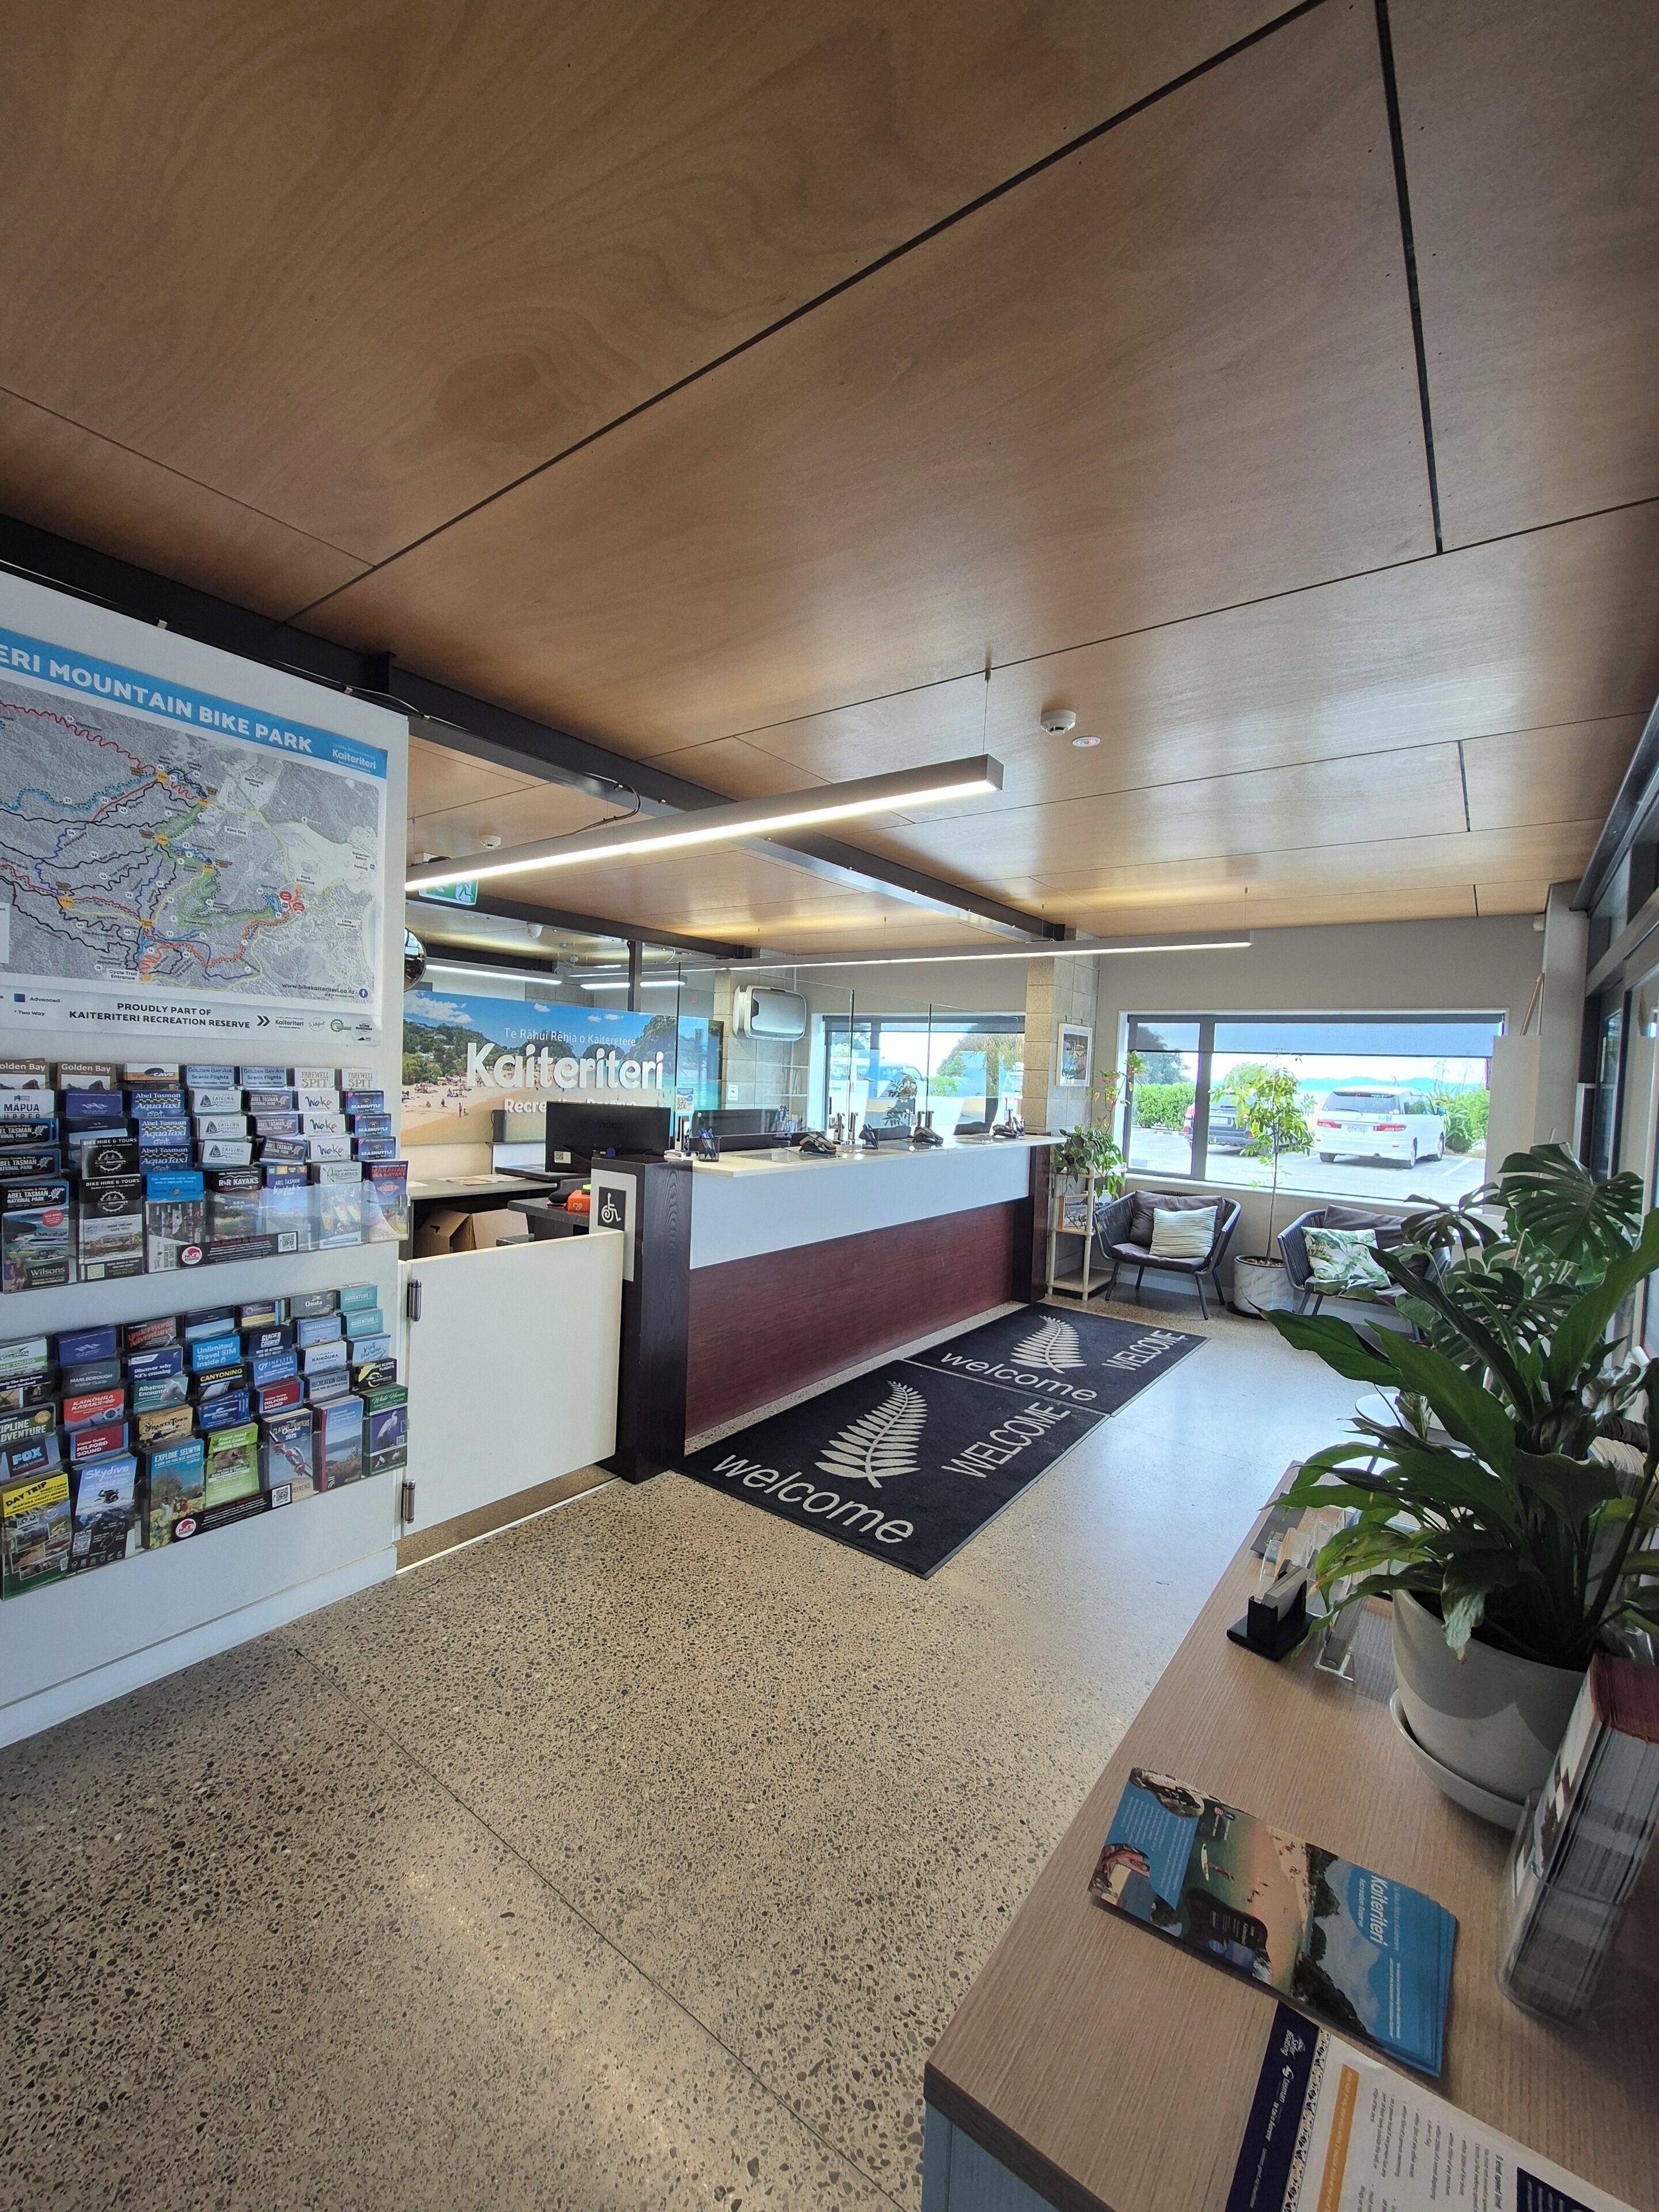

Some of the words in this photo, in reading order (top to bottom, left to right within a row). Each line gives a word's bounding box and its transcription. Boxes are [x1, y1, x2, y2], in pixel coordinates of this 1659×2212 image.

[50, 659, 192, 719] MOUNTAIN
[199, 706, 249, 736] BIKE
[255, 723, 312, 753] PARK
[332, 749, 376, 770] Kaiteriteri
[281, 983, 355, 994] www.bikekaiteriteri.co.nz
[117, 1002, 168, 1013] PROUDLY
[171, 1006, 197, 1016] PART
[69, 1010, 140, 1022] KAITERITERI
[143, 1014, 206, 1027] RECREATION
[208, 1019, 250, 1029] RESERVE
[275, 1019, 304, 1027] Kaiteriteri
[504, 1028, 517, 1038] Te
[520, 1029, 548, 1041] Rāhui
[551, 1031, 577, 1043] Rēhia
[588, 1034, 637, 1047] Kaiteretere
[95, 1065, 111, 1073] Bay
[467, 1042, 664, 1089] Kaiteriteri
[301, 1079, 328, 1088] SPIT
[347, 1080, 373, 1088] SPIT
[4, 1103, 40, 1112] MAPUA
[135, 1101, 180, 1111] AquaTaxi
[305, 1096, 332, 1109] Waka
[310, 1118, 338, 1132] Waka
[142, 1128, 187, 1138] AquaTaxi
[317, 1143, 344, 1158] Waka
[142, 1156, 188, 1165] AquaTaxi
[233, 1177, 259, 1185] KAYAKS
[31, 1267, 66, 1277] Wilsons
[261, 1332, 282, 1342] GLACIER
[196, 1342, 234, 1355] Unlimited
[196, 1353, 220, 1362] Travel
[221, 1347, 237, 1356] SIM
[1101, 1329, 1186, 1372] WELCOME
[12, 1358, 36, 1367] TOURS
[196, 1359, 219, 1368] inside
[268, 1355, 293, 1366] INFLITE
[134, 1366, 158, 1374] Discover
[147, 1369, 171, 1377] crossing
[200, 1368, 243, 1382] CANYONING
[939, 1350, 1099, 1402] welcome
[70, 1373, 113, 1383] MARLBOROUGH
[311, 1378, 336, 1388] RECREATION
[336, 1374, 348, 1382] GUIDE
[71, 1401, 103, 1411] KAYAKS
[264, 1396, 288, 1406] MILFORD
[264, 1402, 283, 1410] SOUND
[291, 1419, 310, 1429] FIGHTERS
[77, 1440, 108, 1453] MILFORD
[940, 1401, 1072, 1479] WELCOME
[12, 1446, 43, 1465] FOX
[77, 1447, 102, 1457] SOUND
[154, 1449, 179, 1463] EXPLORE
[179, 1445, 201, 1457] SELWYN
[84, 1465, 130, 1482] Skydive
[5, 1493, 25, 1507] DAY
[25, 1481, 47, 1496] TRIP
[712, 1453, 915, 1545] welcome
[1358, 1877, 1366, 1906] Recreation
[1369, 1875, 1389, 1947] Kaiteriteri
[1279, 2029, 1294, 2057] Boating
[1289, 2038, 1300, 2056] Safer
[1279, 2078, 1291, 2103] tasman
